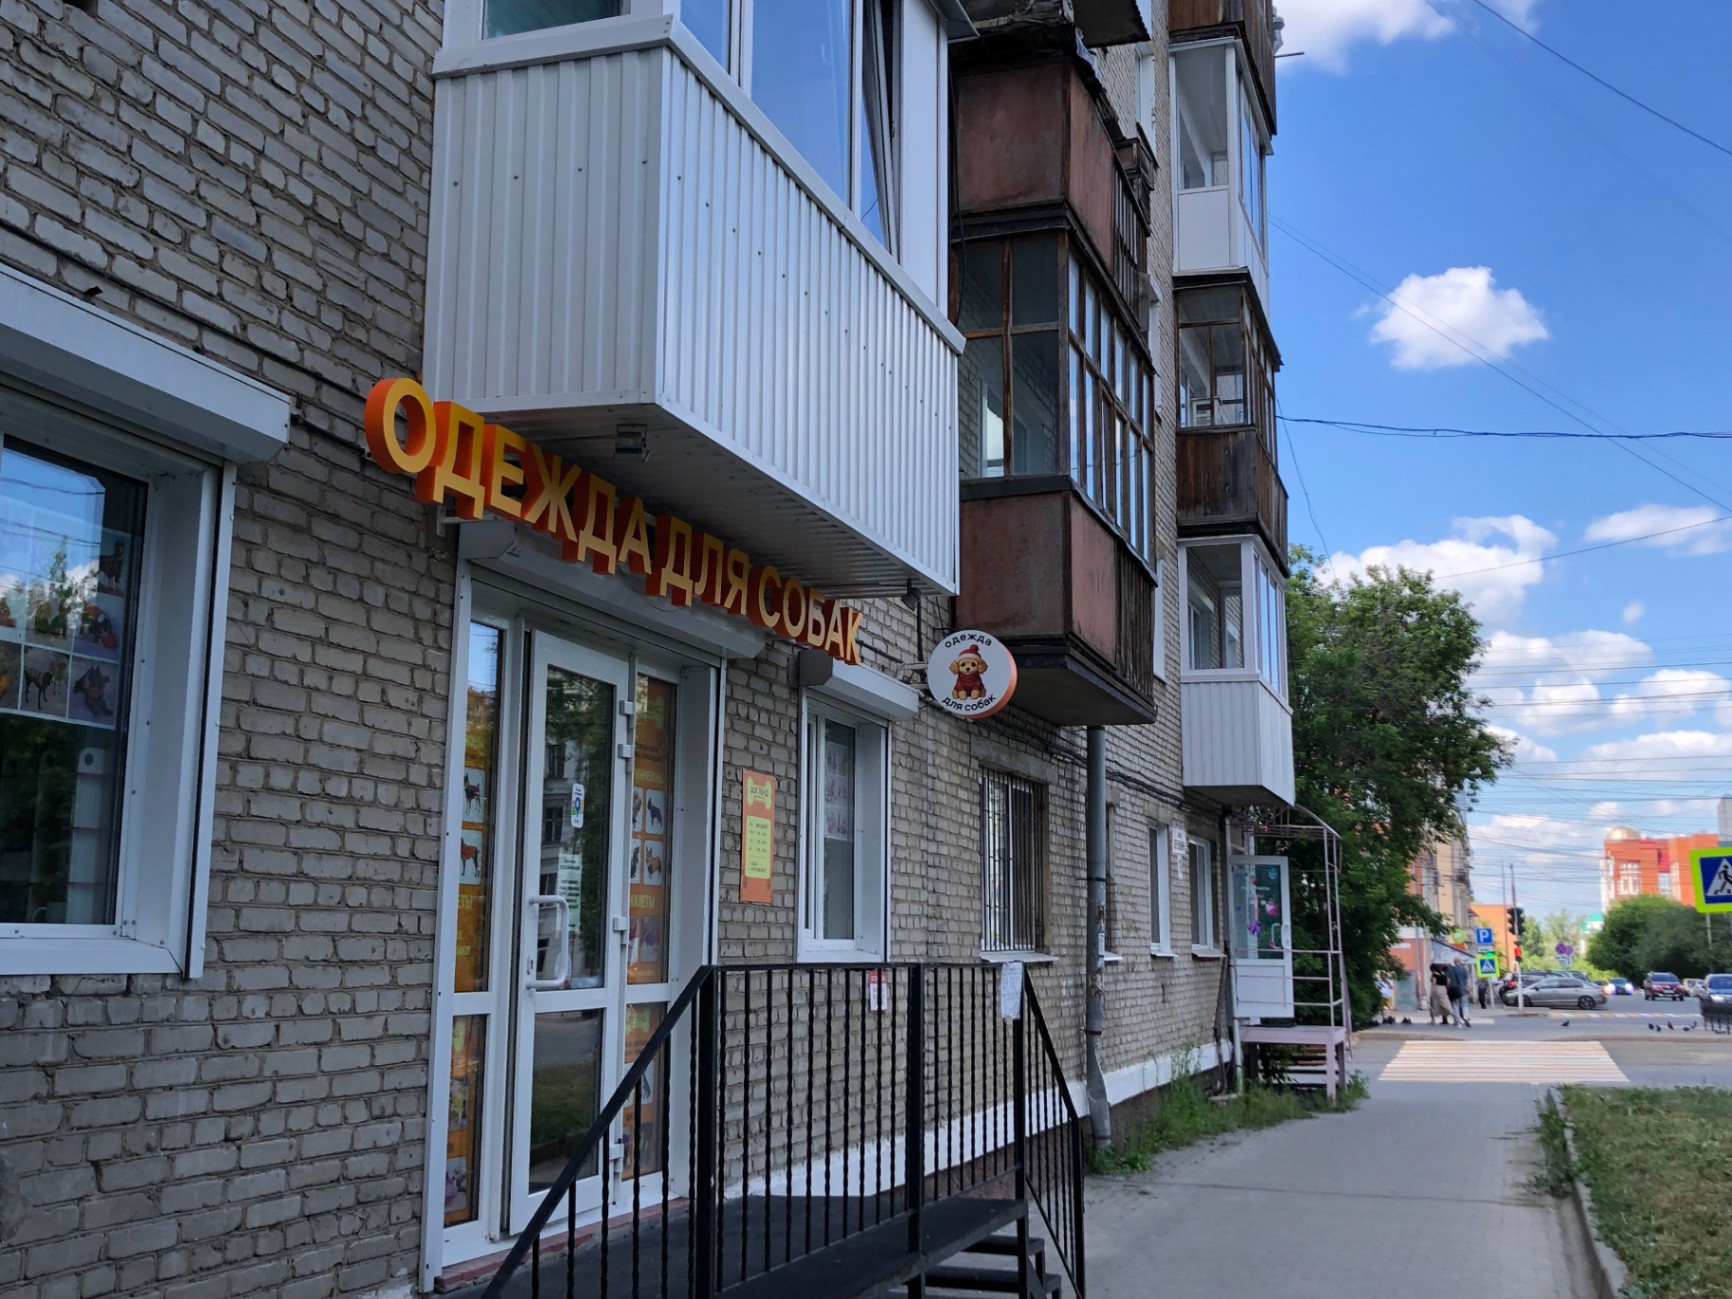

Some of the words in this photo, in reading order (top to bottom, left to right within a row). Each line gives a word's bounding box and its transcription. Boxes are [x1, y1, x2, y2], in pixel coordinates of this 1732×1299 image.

[380, 378, 653, 575] ОДЕЖДА
[658, 516, 749, 616] ДЛЯ
[757, 564, 863, 666] СОБАК
[944, 633, 992, 648] одежда
[942, 696, 963, 711] для
[964, 694, 997, 711] собак
